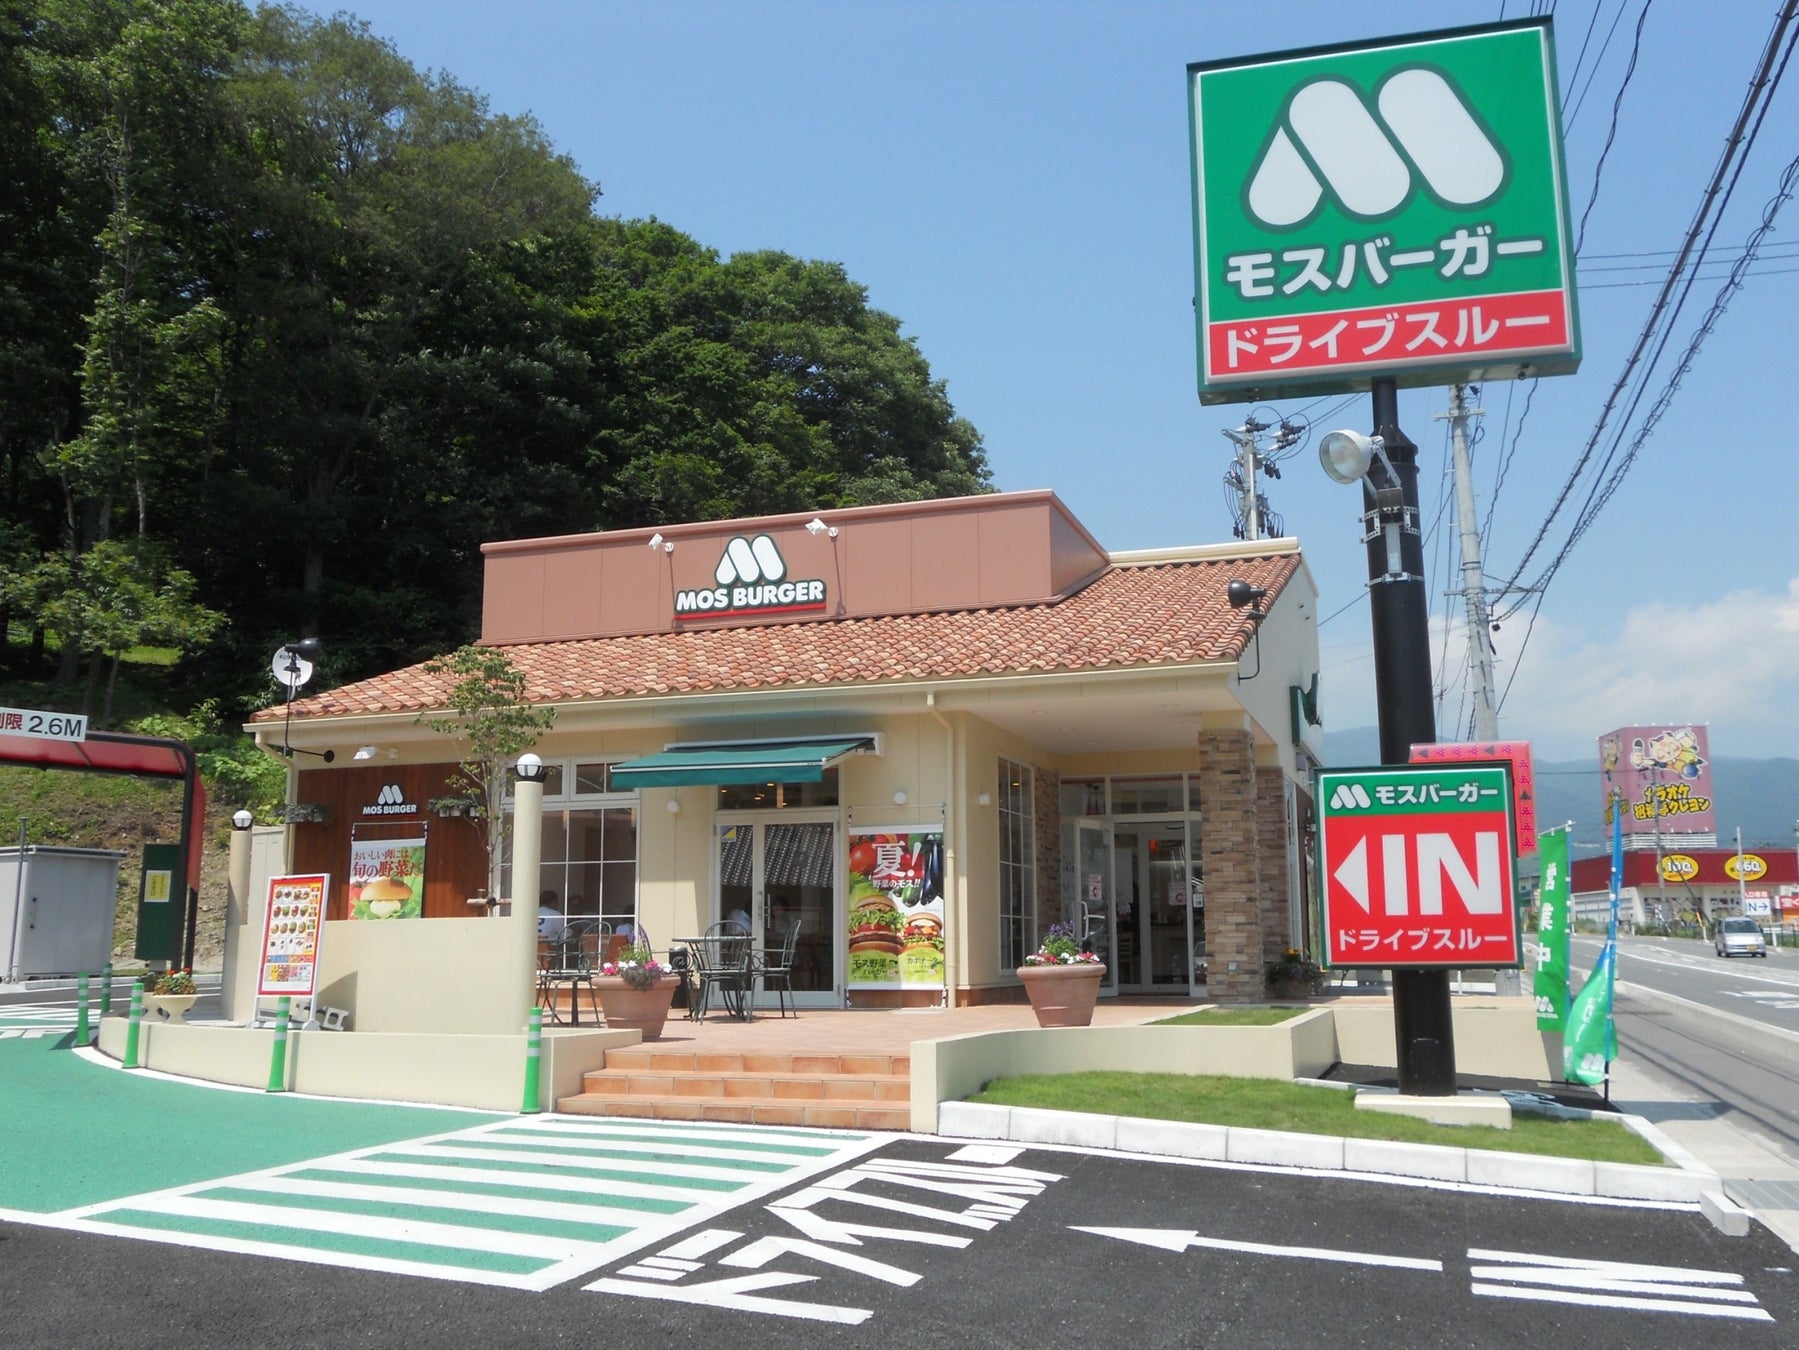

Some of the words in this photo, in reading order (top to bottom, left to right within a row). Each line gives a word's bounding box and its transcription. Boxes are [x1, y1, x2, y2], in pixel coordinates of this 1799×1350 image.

[1226, 225, 1543, 297] モスバーガー
[1227, 306, 1551, 368] ドライブスルー
[676, 588, 728, 611] MOS
[733, 581, 824, 607] BURGER
[28, 715, 82, 737] 2.6M
[1375, 781, 1498, 805] モスバーガー
[363, 805, 382, 815] MOS
[383, 804, 417, 814] BURGER
[1381, 831, 1503, 916] IN
[1339, 928, 1508, 952] ドライブスルー
